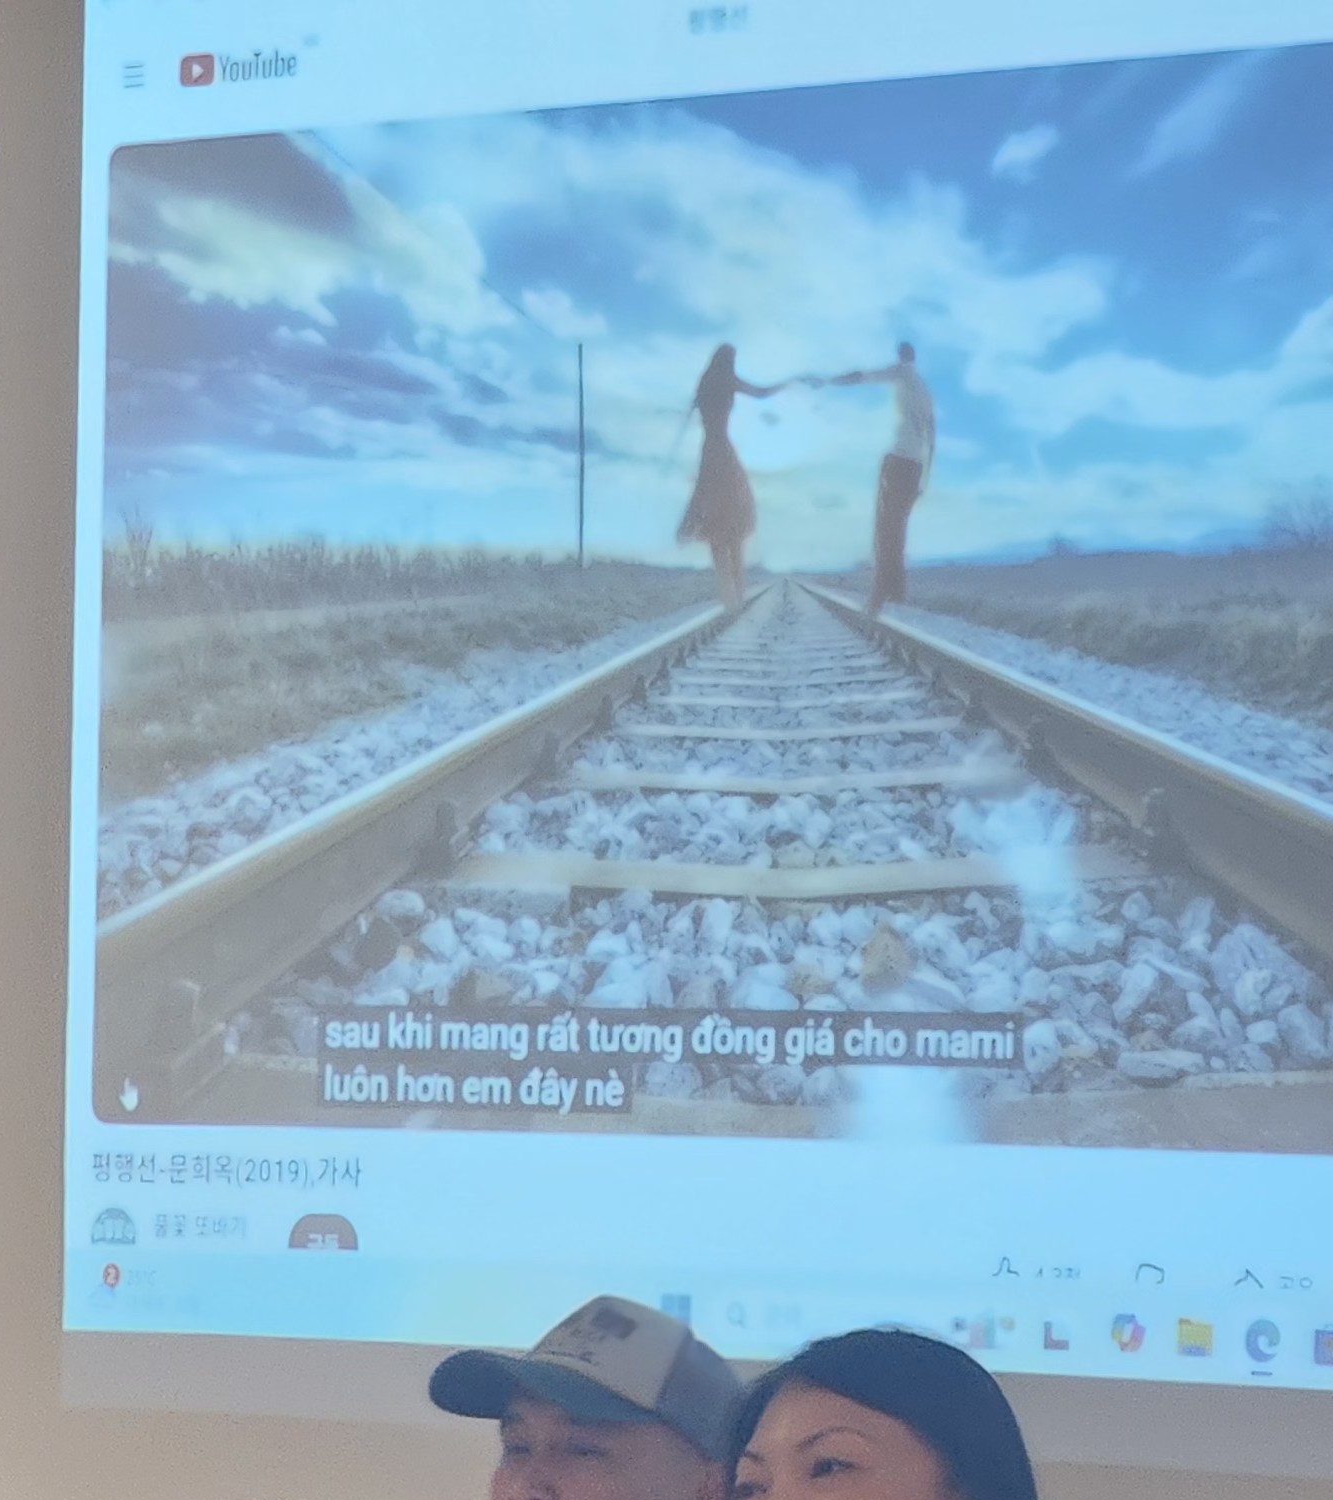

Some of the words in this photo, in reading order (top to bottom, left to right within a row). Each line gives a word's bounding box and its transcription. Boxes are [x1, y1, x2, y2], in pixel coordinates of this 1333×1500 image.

[219, 49, 298, 82] YouTube
[325, 1020, 380, 1049] sau
[388, 1011, 433, 1050] khi
[439, 1021, 529, 1061] mang
[536, 1010, 580, 1052] rất
[587, 1017, 683, 1063] tương
[691, 1012, 776, 1064] đồng
[784, 1017, 835, 1065] giá
[843, 1016, 908, 1057] cho
[916, 1021, 1015, 1060] mami
[324, 1063, 389, 1101] luôn
[396, 1063, 454, 1104] hơn
[461, 1075, 512, 1105] em
[519, 1067, 578, 1115] đây
[585, 1068, 625, 1107] nè
